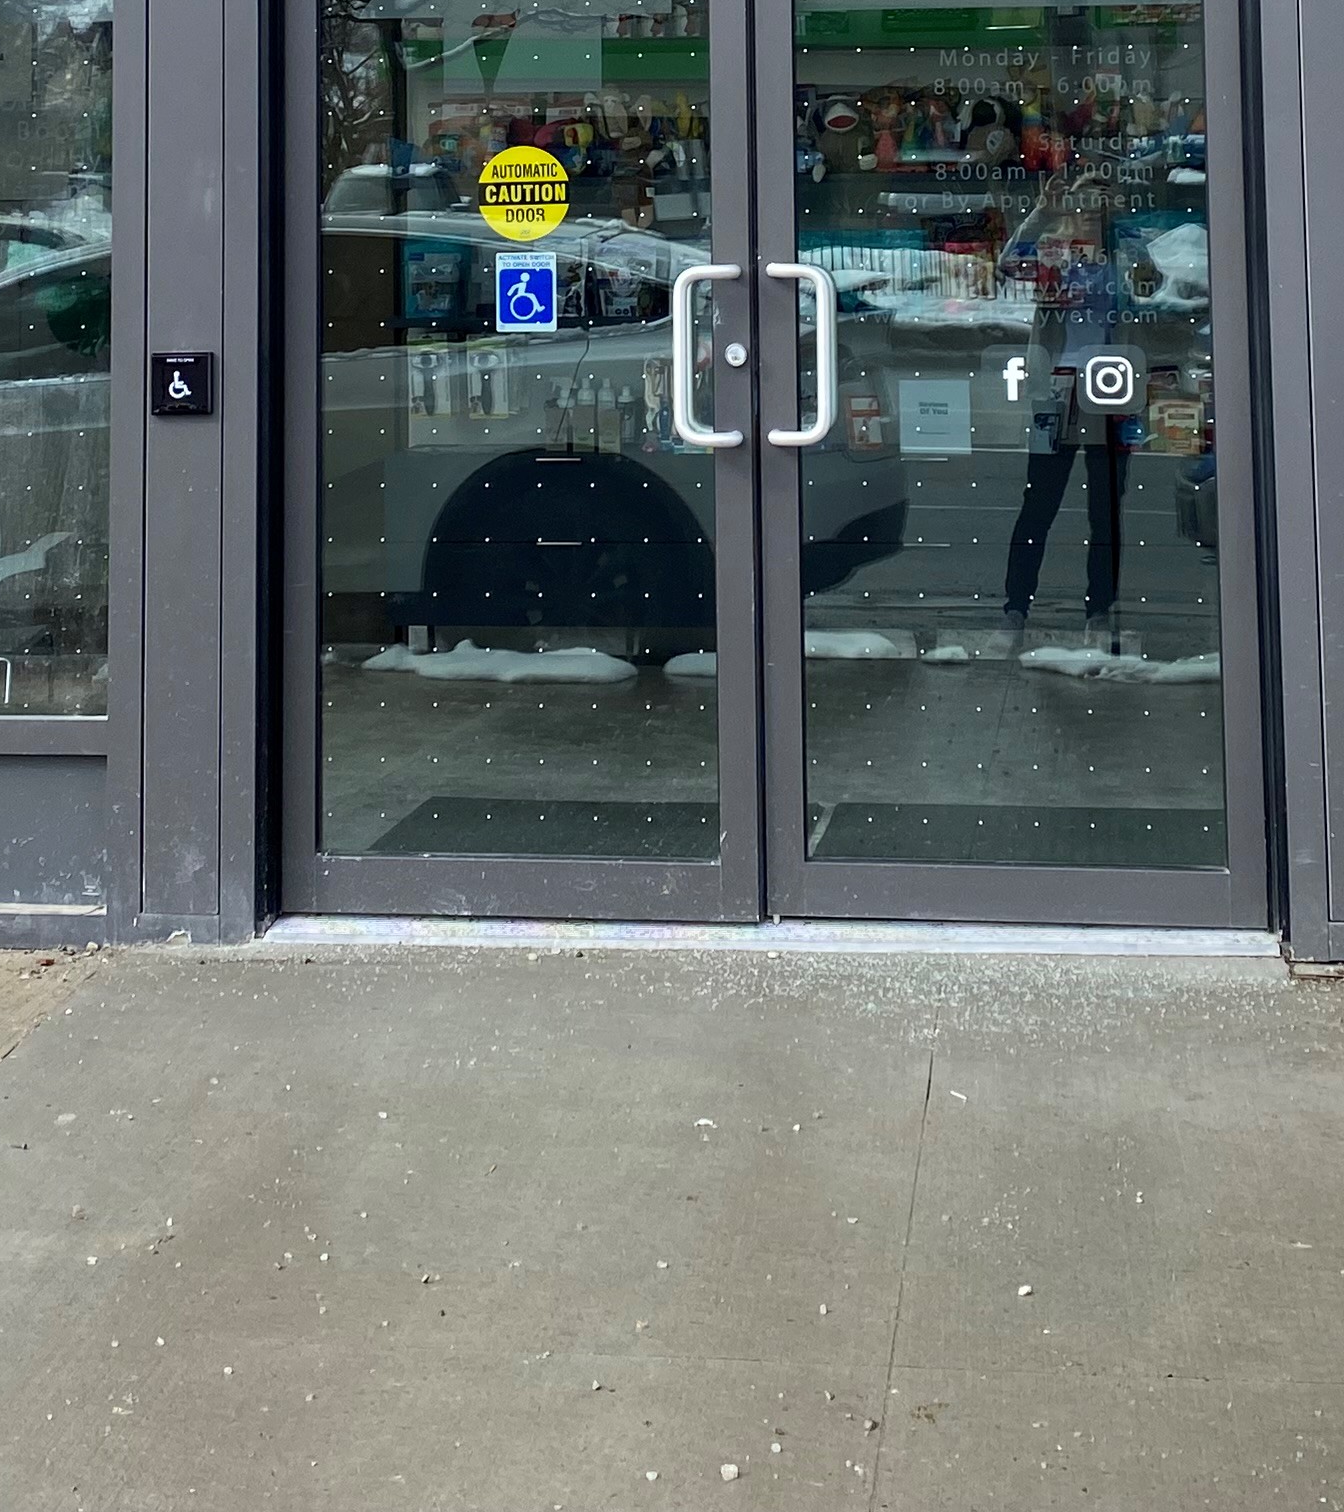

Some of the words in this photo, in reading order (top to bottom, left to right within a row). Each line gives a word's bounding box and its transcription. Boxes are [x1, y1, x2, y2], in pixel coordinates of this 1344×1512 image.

[940, 49, 1040, 72] Monday
[1072, 46, 1152, 69] Friday
[934, 77, 1024, 95] 8:00am
[492, 163, 558, 179] AUTOMATIC
[935, 163, 1026, 181] 8:00am
[1062, 162, 1154, 186] 1:00pm
[485, 183, 566, 203] CAUTION
[905, 195, 927, 209] or
[943, 191, 967, 214] By
[983, 190, 1156, 215] Appointment
[505, 208, 546, 223] DOOR
